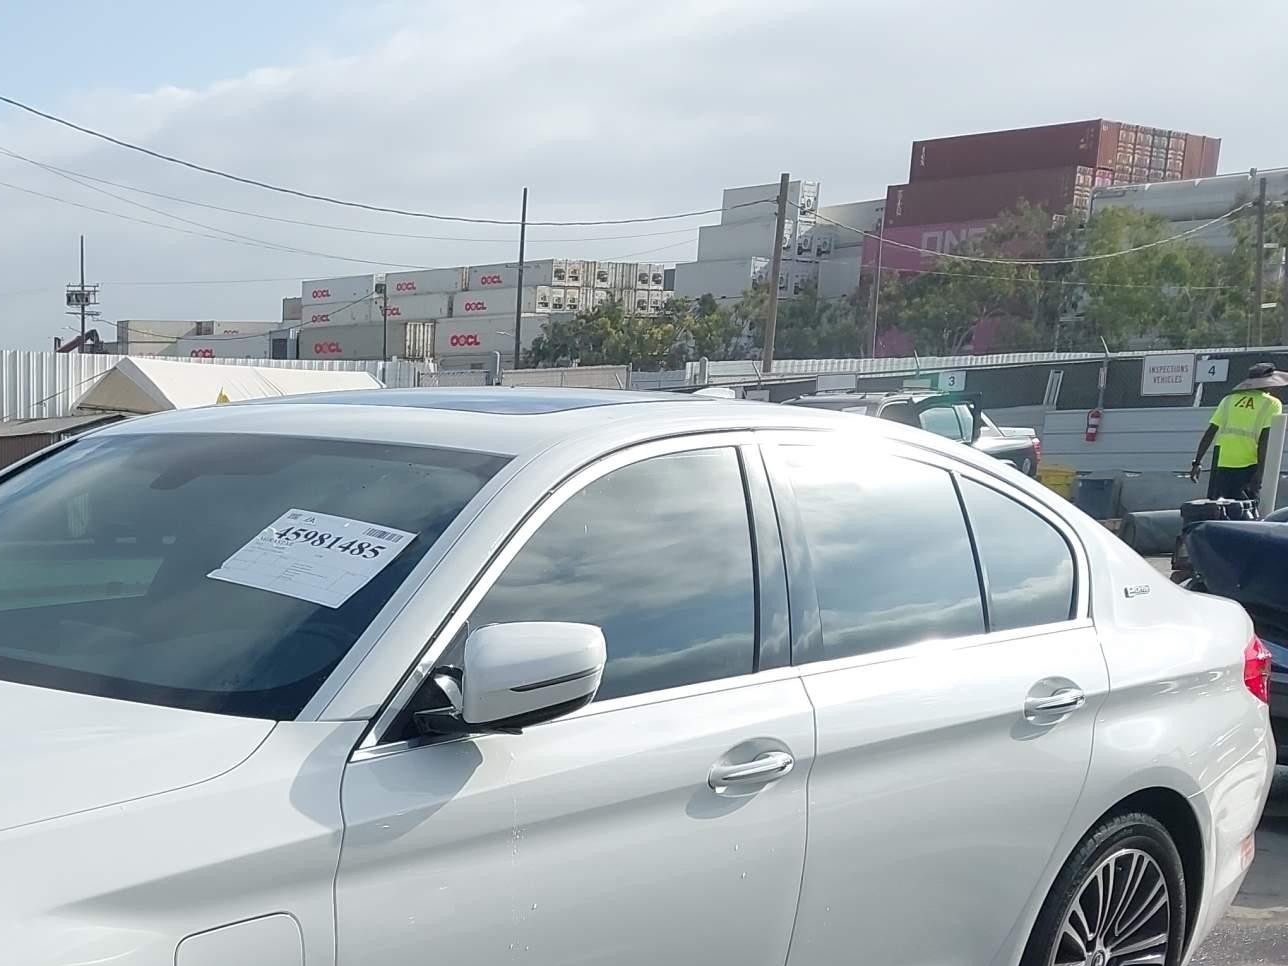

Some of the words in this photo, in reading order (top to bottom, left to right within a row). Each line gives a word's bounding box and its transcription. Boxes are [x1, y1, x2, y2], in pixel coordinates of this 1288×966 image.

[480, 275, 503, 285] OOCL
[396, 282, 416, 291] OOCL
[312, 289, 331, 298] OOCL
[464, 301, 487, 311] OOCL
[450, 334, 480, 346] OOCL
[314, 342, 342, 353] OOCL
[1208, 365, 1216, 376] 4
[948, 376, 955, 386] 3
[275, 526, 387, 559] 45981485
